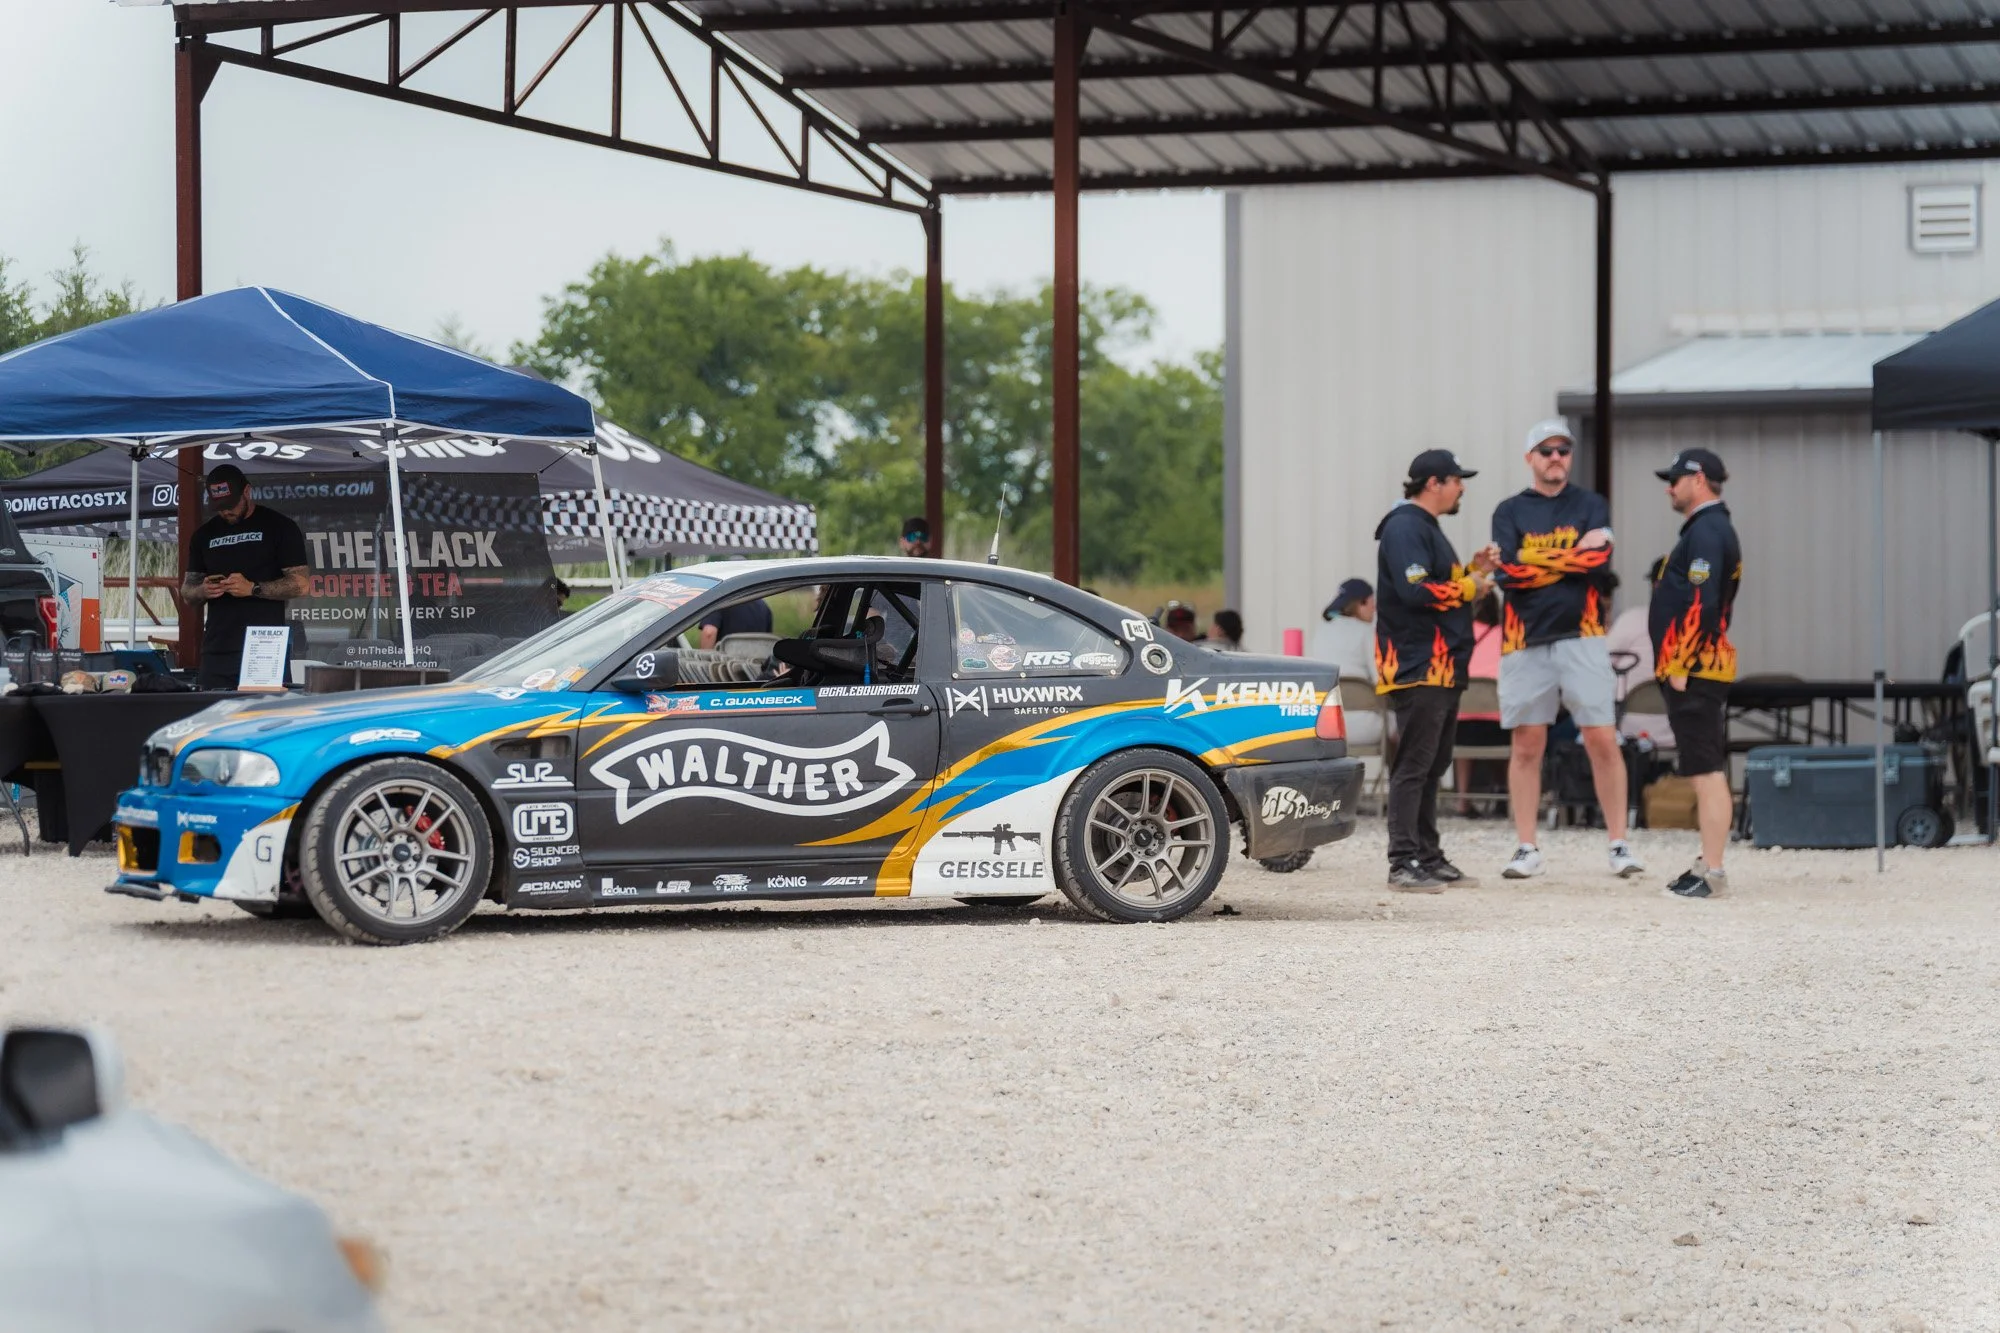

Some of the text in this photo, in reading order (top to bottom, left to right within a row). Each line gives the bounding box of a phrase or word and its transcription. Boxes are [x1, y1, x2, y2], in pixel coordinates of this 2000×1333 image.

[249, 481, 374, 500] MGTACOS.COM
[211, 533, 261, 547] IN THE BLACK
[306, 531, 376, 569] THE
[309, 573, 392, 598] COFFEE
[418, 573, 463, 597] TEA
[291, 607, 366, 620] FREEDOM
[373, 607, 389, 619] IN
[450, 607, 476, 619] SIP
[1132, 625, 1144, 633] HC
[358, 645, 432, 656] InTheBlaHQ
[344, 660, 438, 668] InTheBlackH.com
[1023, 651, 1072, 666] RTS
[993, 685, 1084, 704] HUXWRX
[1215, 681, 1317, 705] KENDA
[710, 698, 724, 707] C.
[725, 695, 804, 707] QUANBECK
[1014, 706, 1069, 715] SAFETY CO.
[1279, 705, 1319, 717] TIRES
[493, 762, 569, 784] SLR
[636, 744, 863, 801] WALTHER
[520, 810, 567, 836] LME
[255, 834, 273, 862] G
[530, 845, 580, 857] SILENCER
[530, 857, 562, 867] SHOP
[938, 861, 1044, 879] GEISSELE
[656, 880, 692, 894] LSR
[767, 875, 808, 888] KÖNIG
